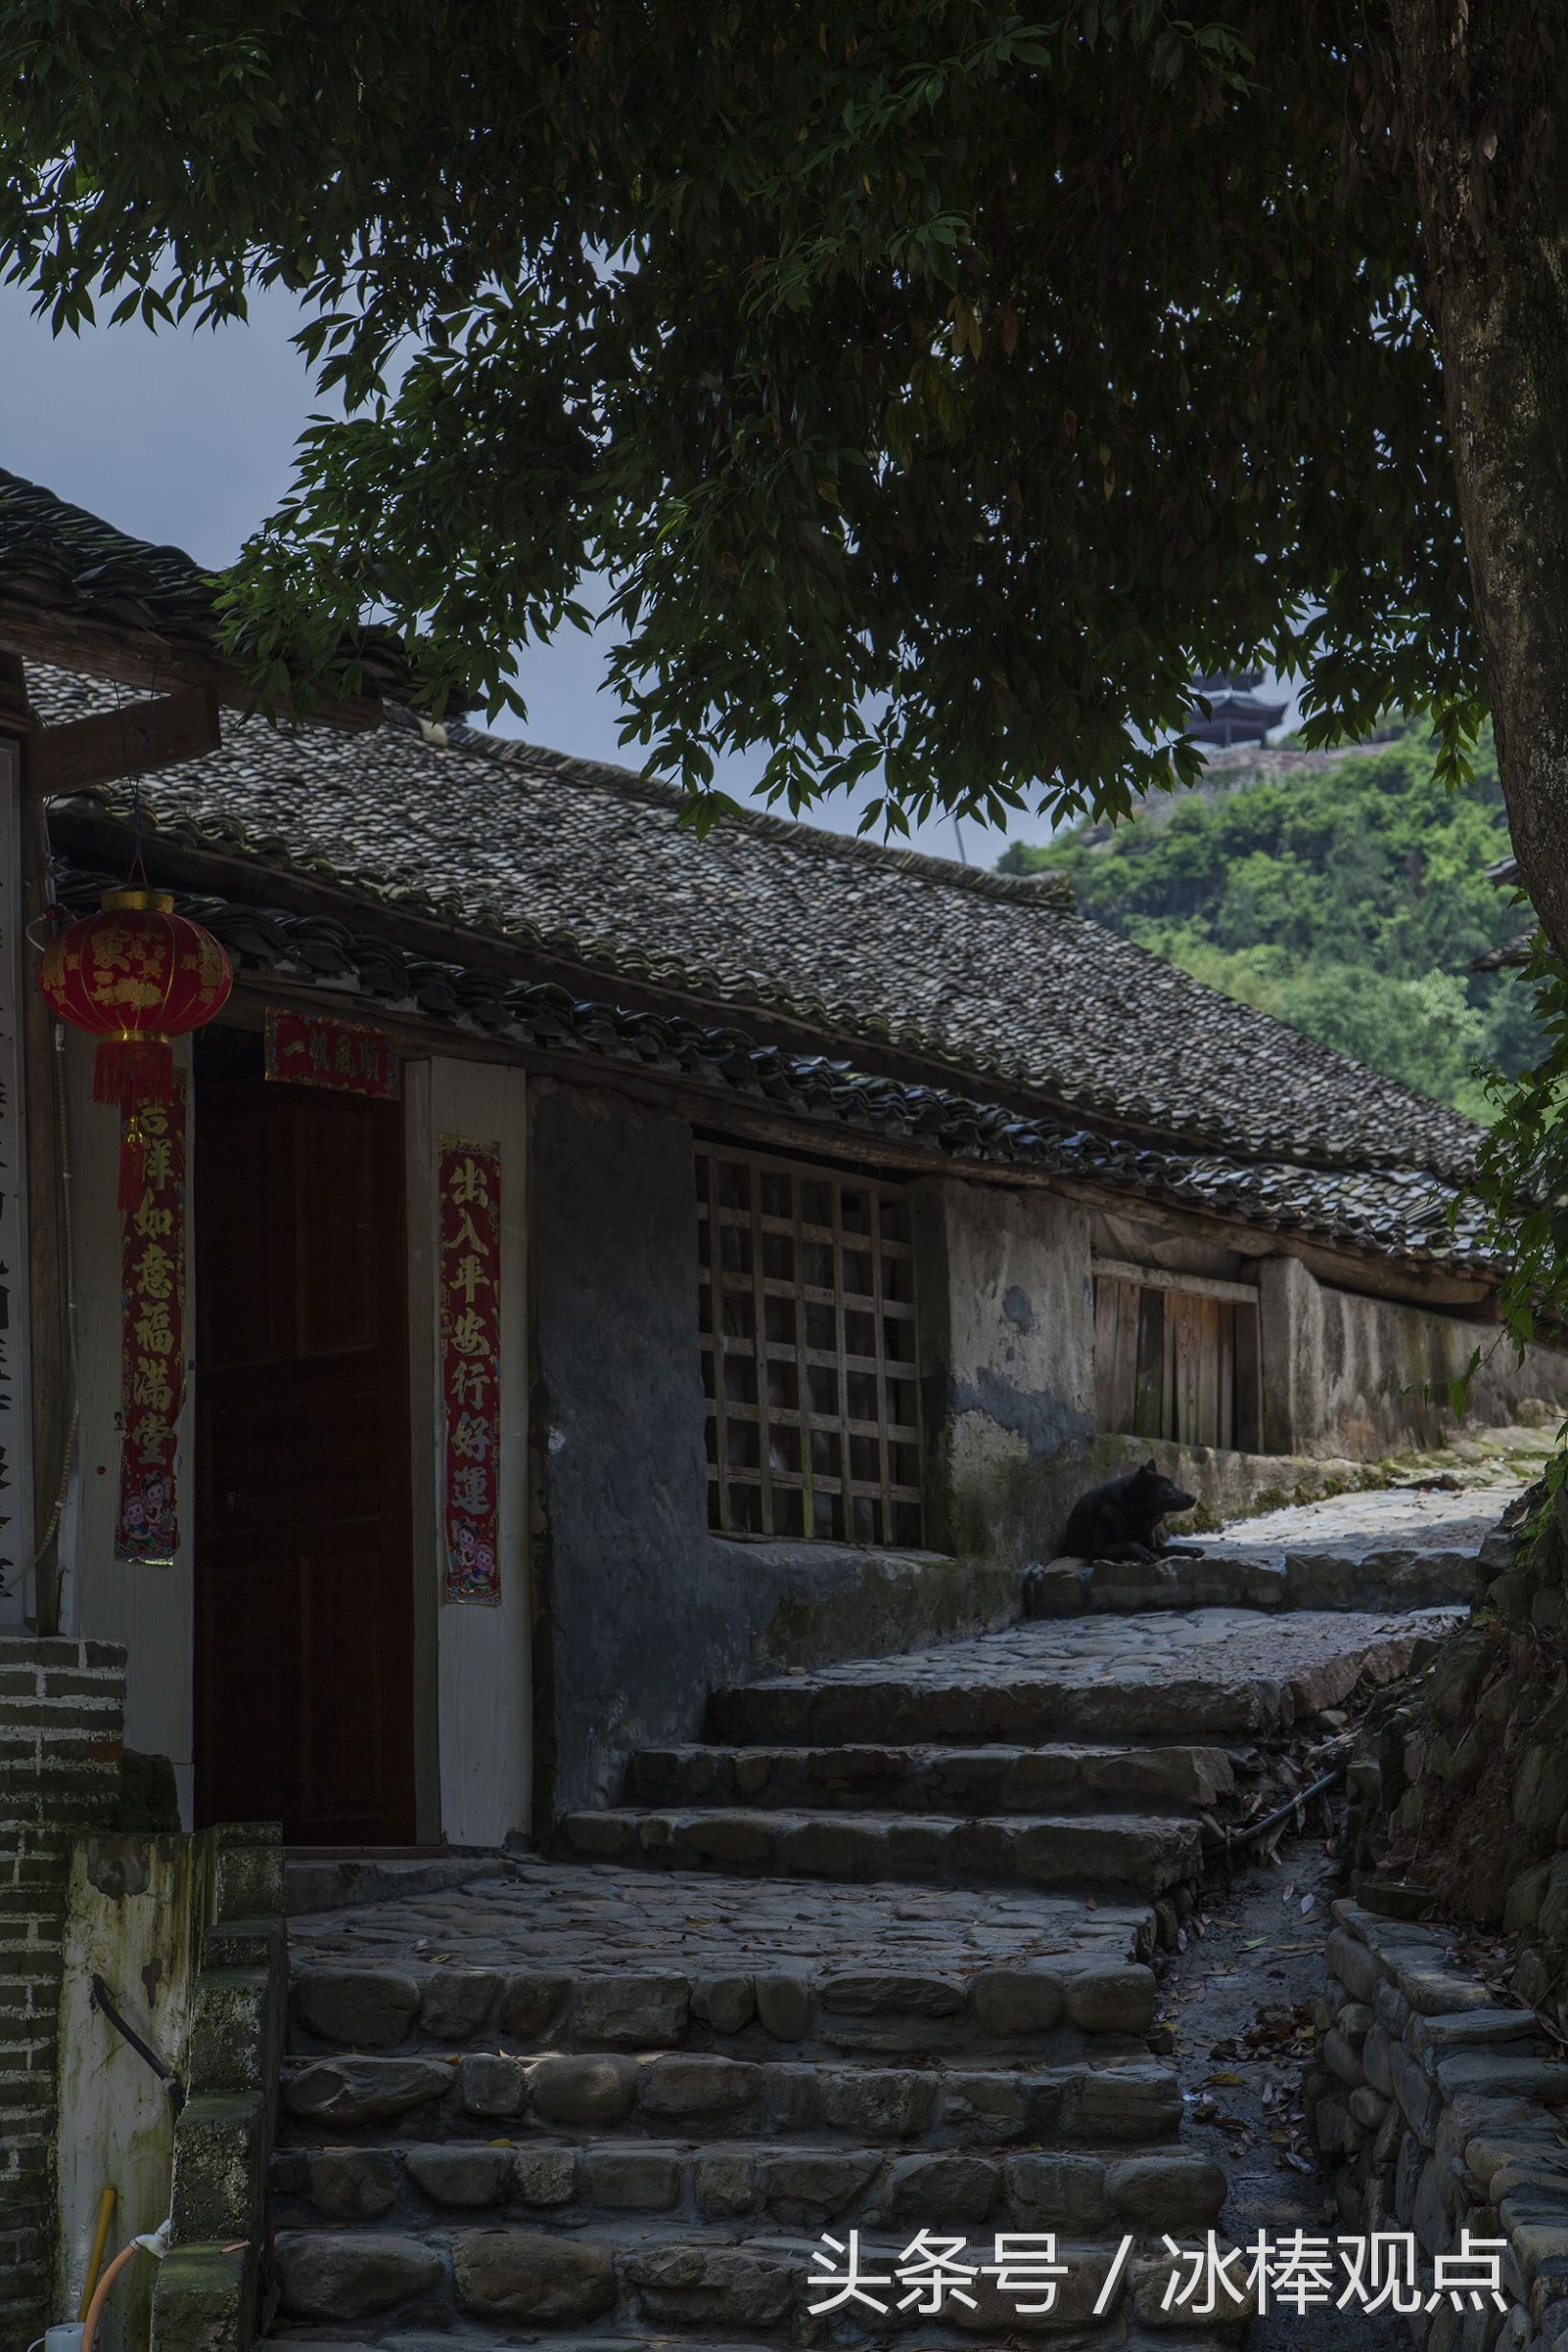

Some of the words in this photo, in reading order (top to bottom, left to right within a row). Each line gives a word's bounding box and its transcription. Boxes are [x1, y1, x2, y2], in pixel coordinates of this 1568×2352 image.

[449, 1156, 491, 1515] 出入平安行好運
